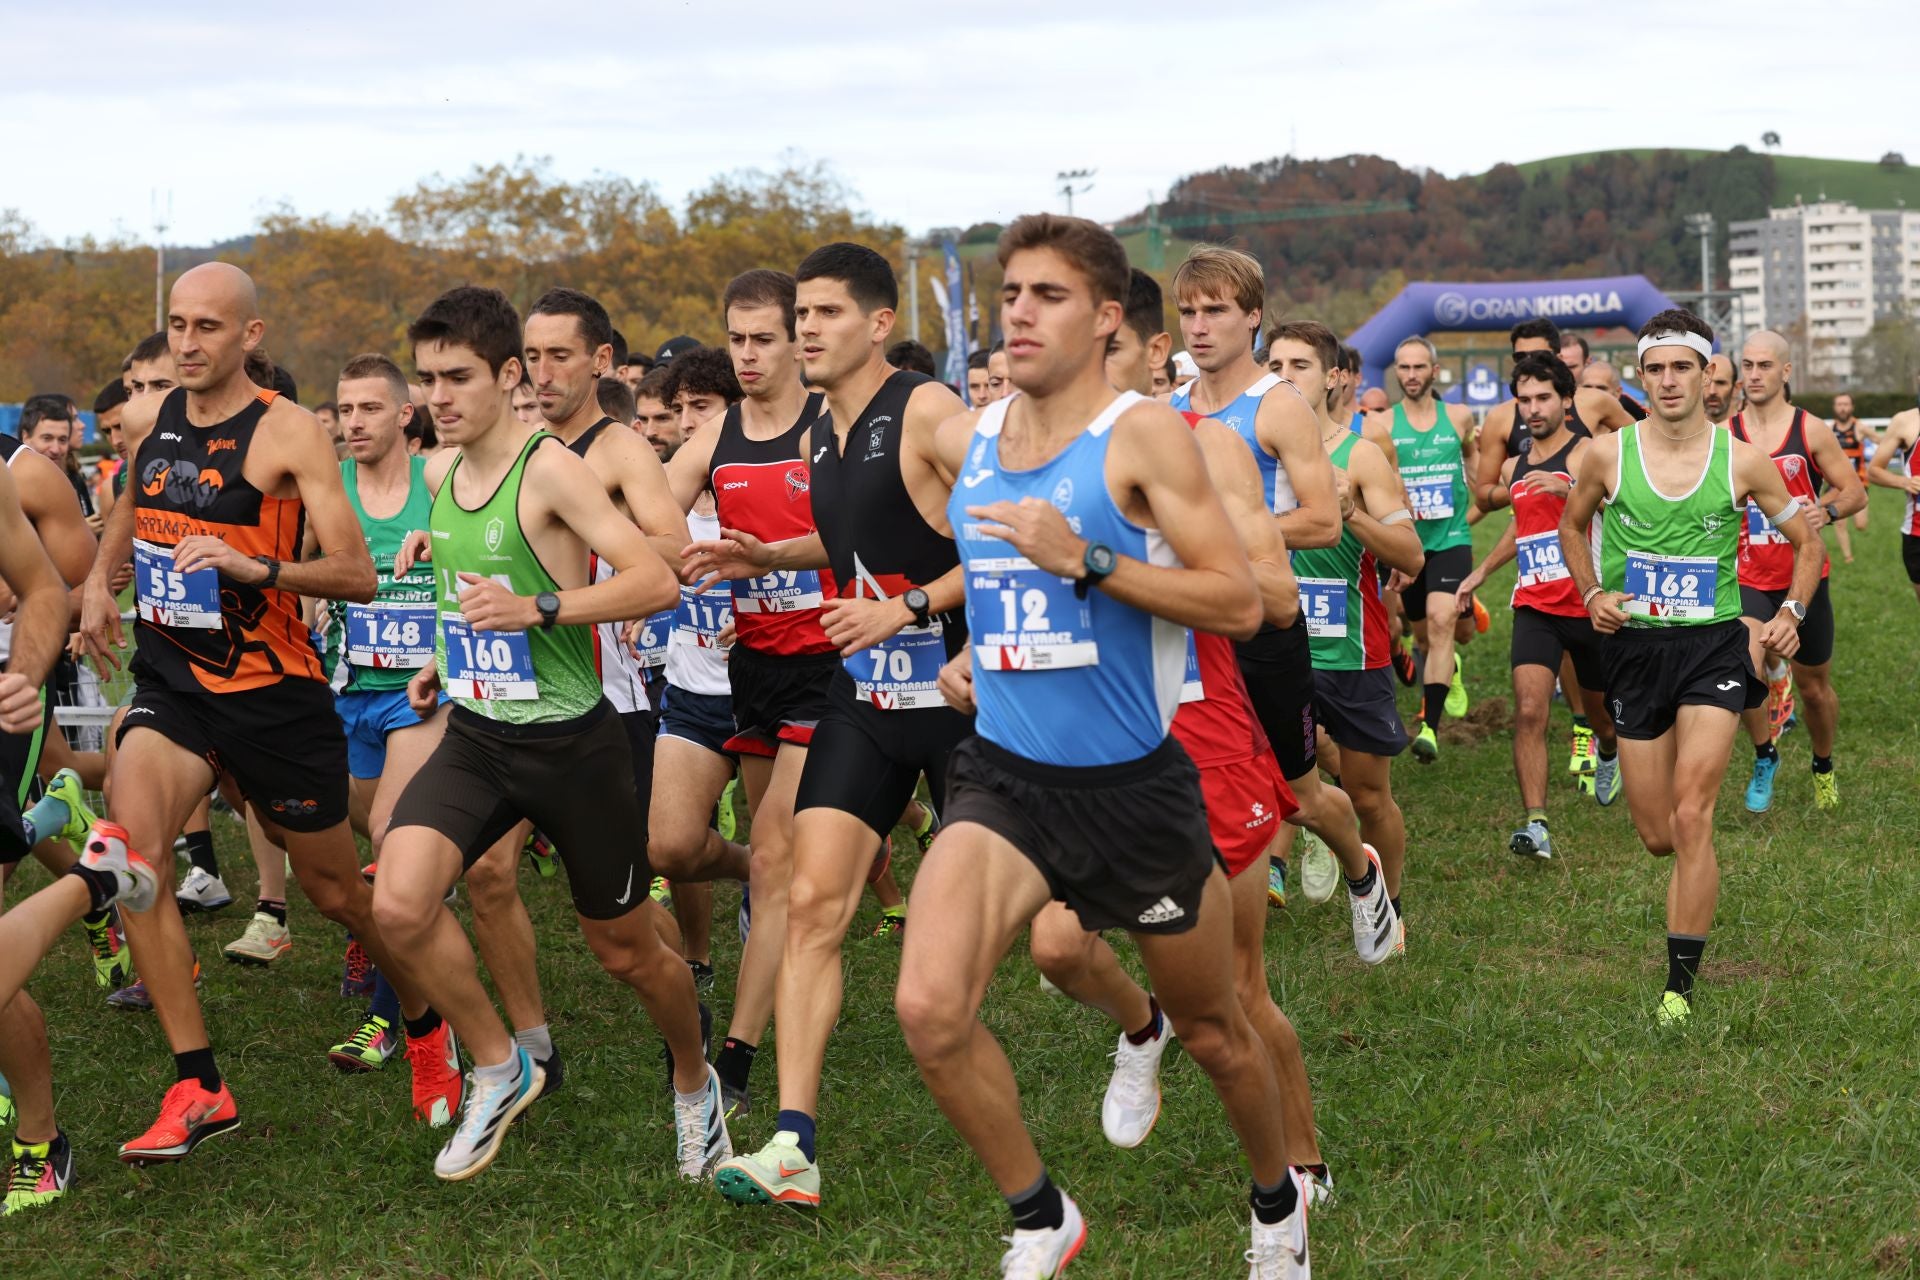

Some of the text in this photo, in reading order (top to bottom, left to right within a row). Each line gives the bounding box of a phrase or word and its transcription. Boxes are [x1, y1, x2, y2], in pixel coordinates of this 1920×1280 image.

[1409, 490, 1444, 507] 236
[1526, 544, 1560, 569] 140
[1632, 560, 1642, 569] 69
[151, 567, 187, 601] 55
[768, 589, 802, 598] LOBATO
[1645, 571, 1699, 597] 162
[164, 601, 204, 613] PASCUAL
[1000, 588, 1050, 632] 12
[1638, 594, 1700, 607] JULEN AZPIAZU
[352, 610, 363, 619] 69
[687, 603, 735, 631] 116
[366, 620, 421, 646] 148
[352, 644, 374, 653] CARLOS
[375, 645, 405, 654] ANTONIO
[461, 637, 513, 672] 160
[459, 670, 475, 680] JON
[870, 649, 912, 681] 70
